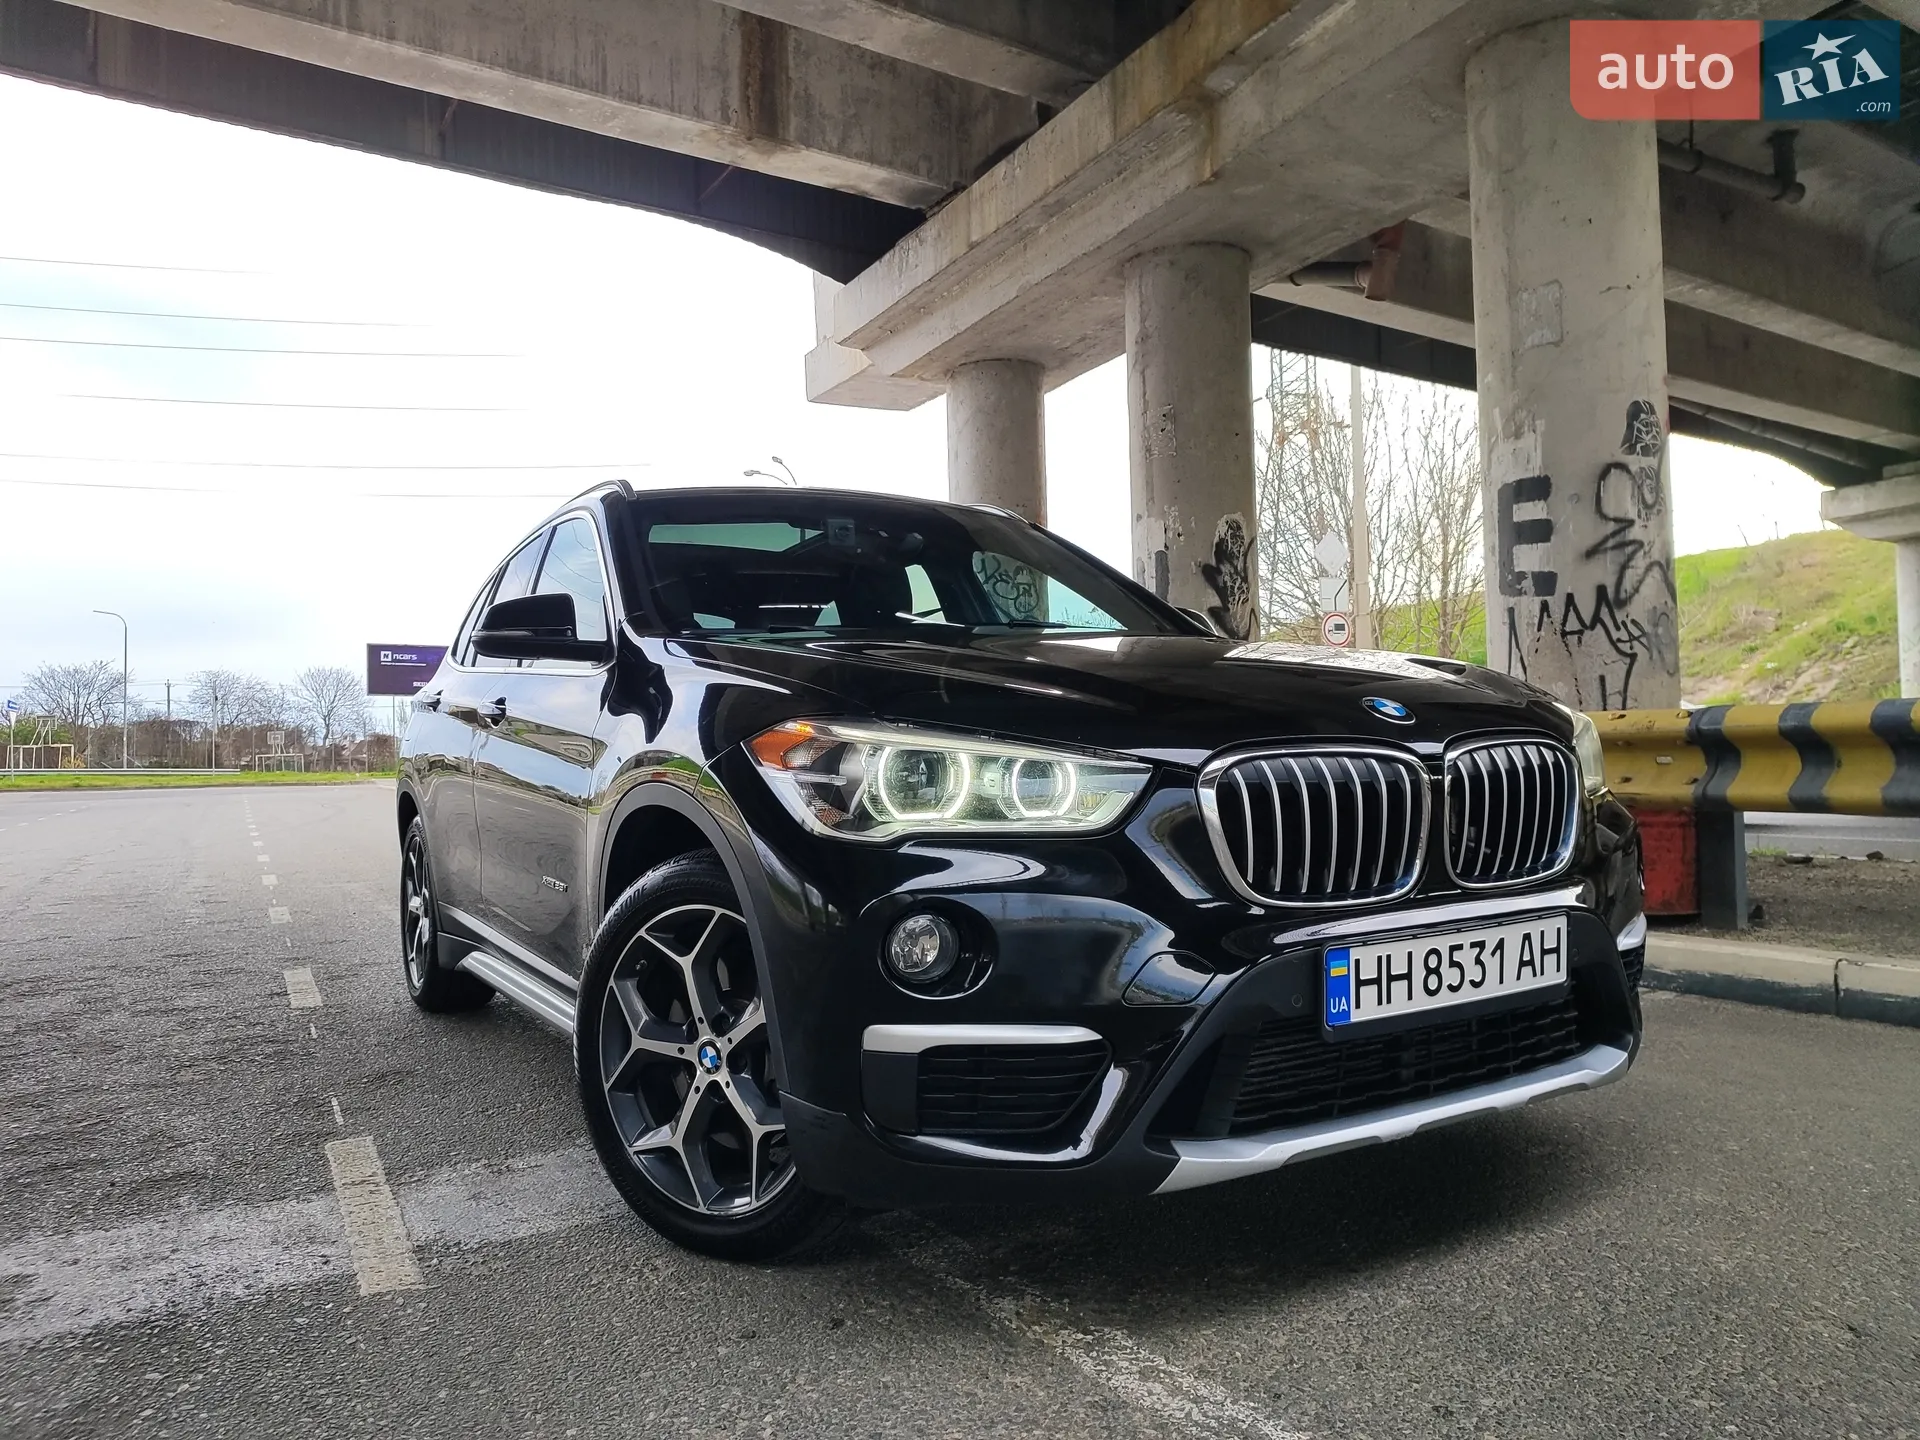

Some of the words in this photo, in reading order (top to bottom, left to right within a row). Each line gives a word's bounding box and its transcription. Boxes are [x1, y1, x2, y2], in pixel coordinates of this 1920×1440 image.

[393, 653, 418, 661] ncars
[1354, 951, 1413, 1009] HH
[1423, 937, 1505, 997] 8531
[1516, 927, 1561, 981] AH
[1330, 996, 1348, 1013] UA
